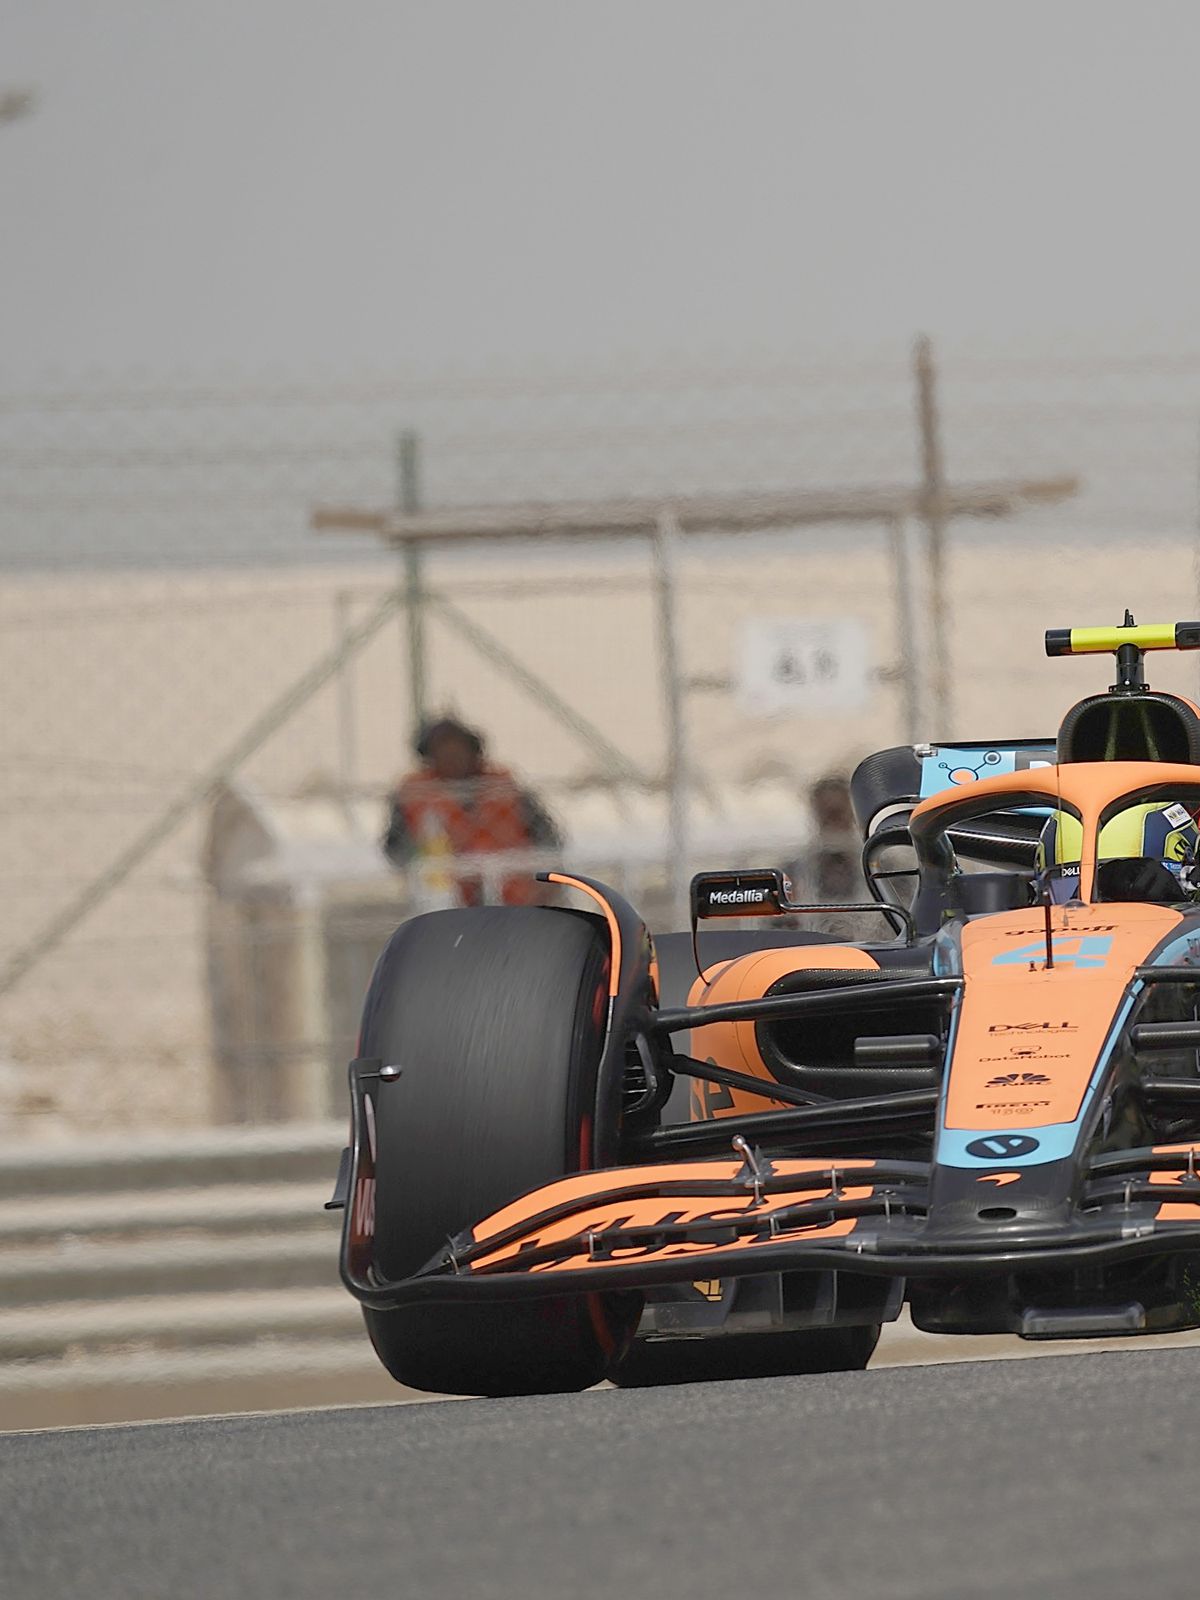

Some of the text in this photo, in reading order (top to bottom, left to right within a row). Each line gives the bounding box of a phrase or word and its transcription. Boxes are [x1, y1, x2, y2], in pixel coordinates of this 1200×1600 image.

[709, 889, 764, 904] Medallia
[991, 935, 1114, 969] 4
[988, 1022, 1079, 1033] DELL
